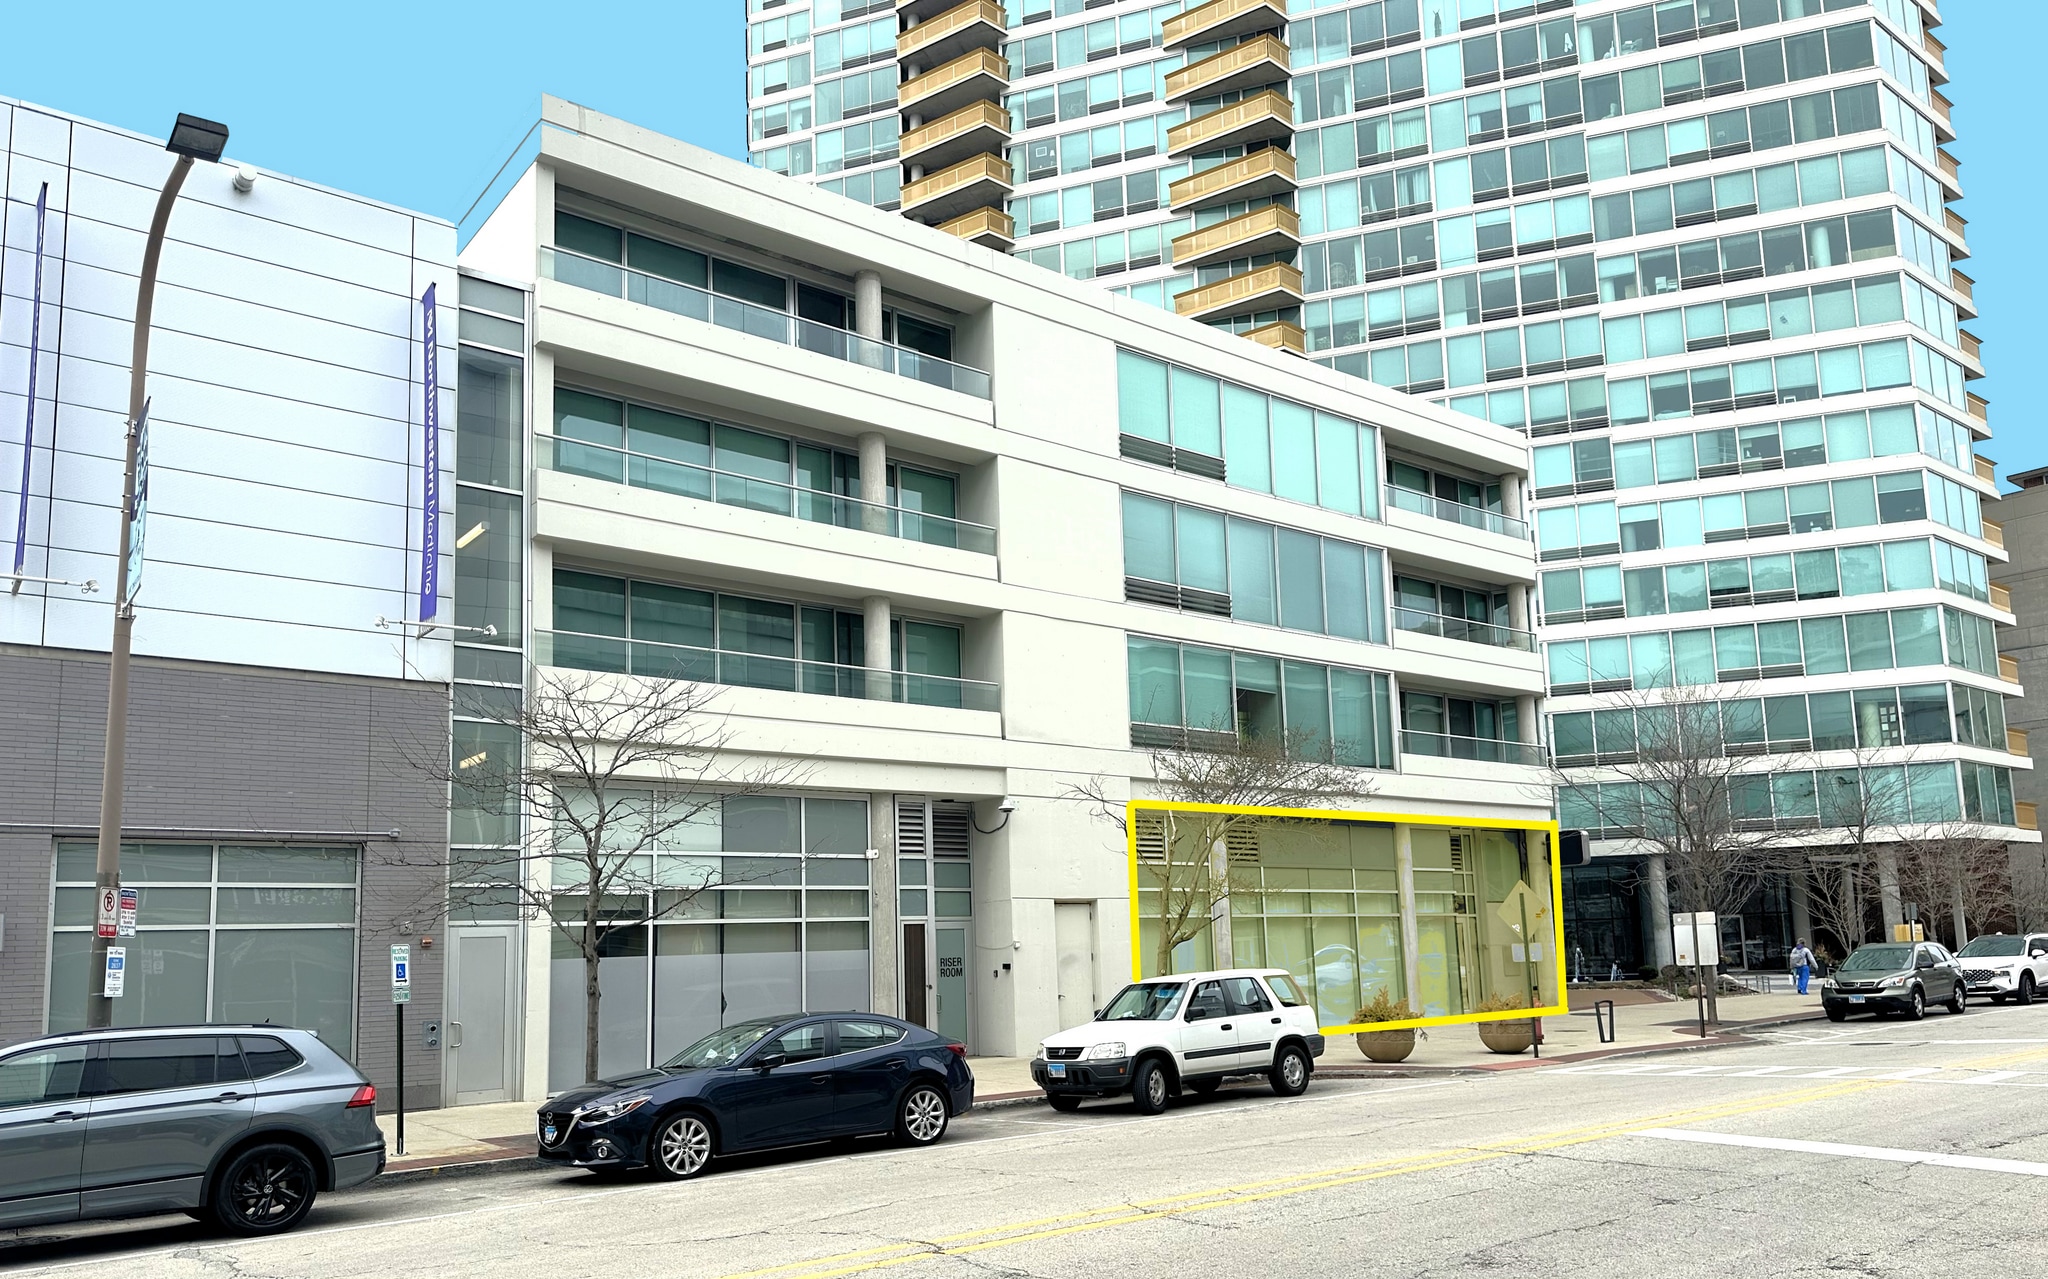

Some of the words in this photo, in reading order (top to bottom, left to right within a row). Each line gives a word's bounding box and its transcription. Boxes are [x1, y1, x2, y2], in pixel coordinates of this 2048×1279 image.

[427, 340, 436, 496] Northwestern
[424, 499, 435, 595] Medicine
[940, 957, 962, 967] RISER
[940, 967, 963, 977] ROOM
